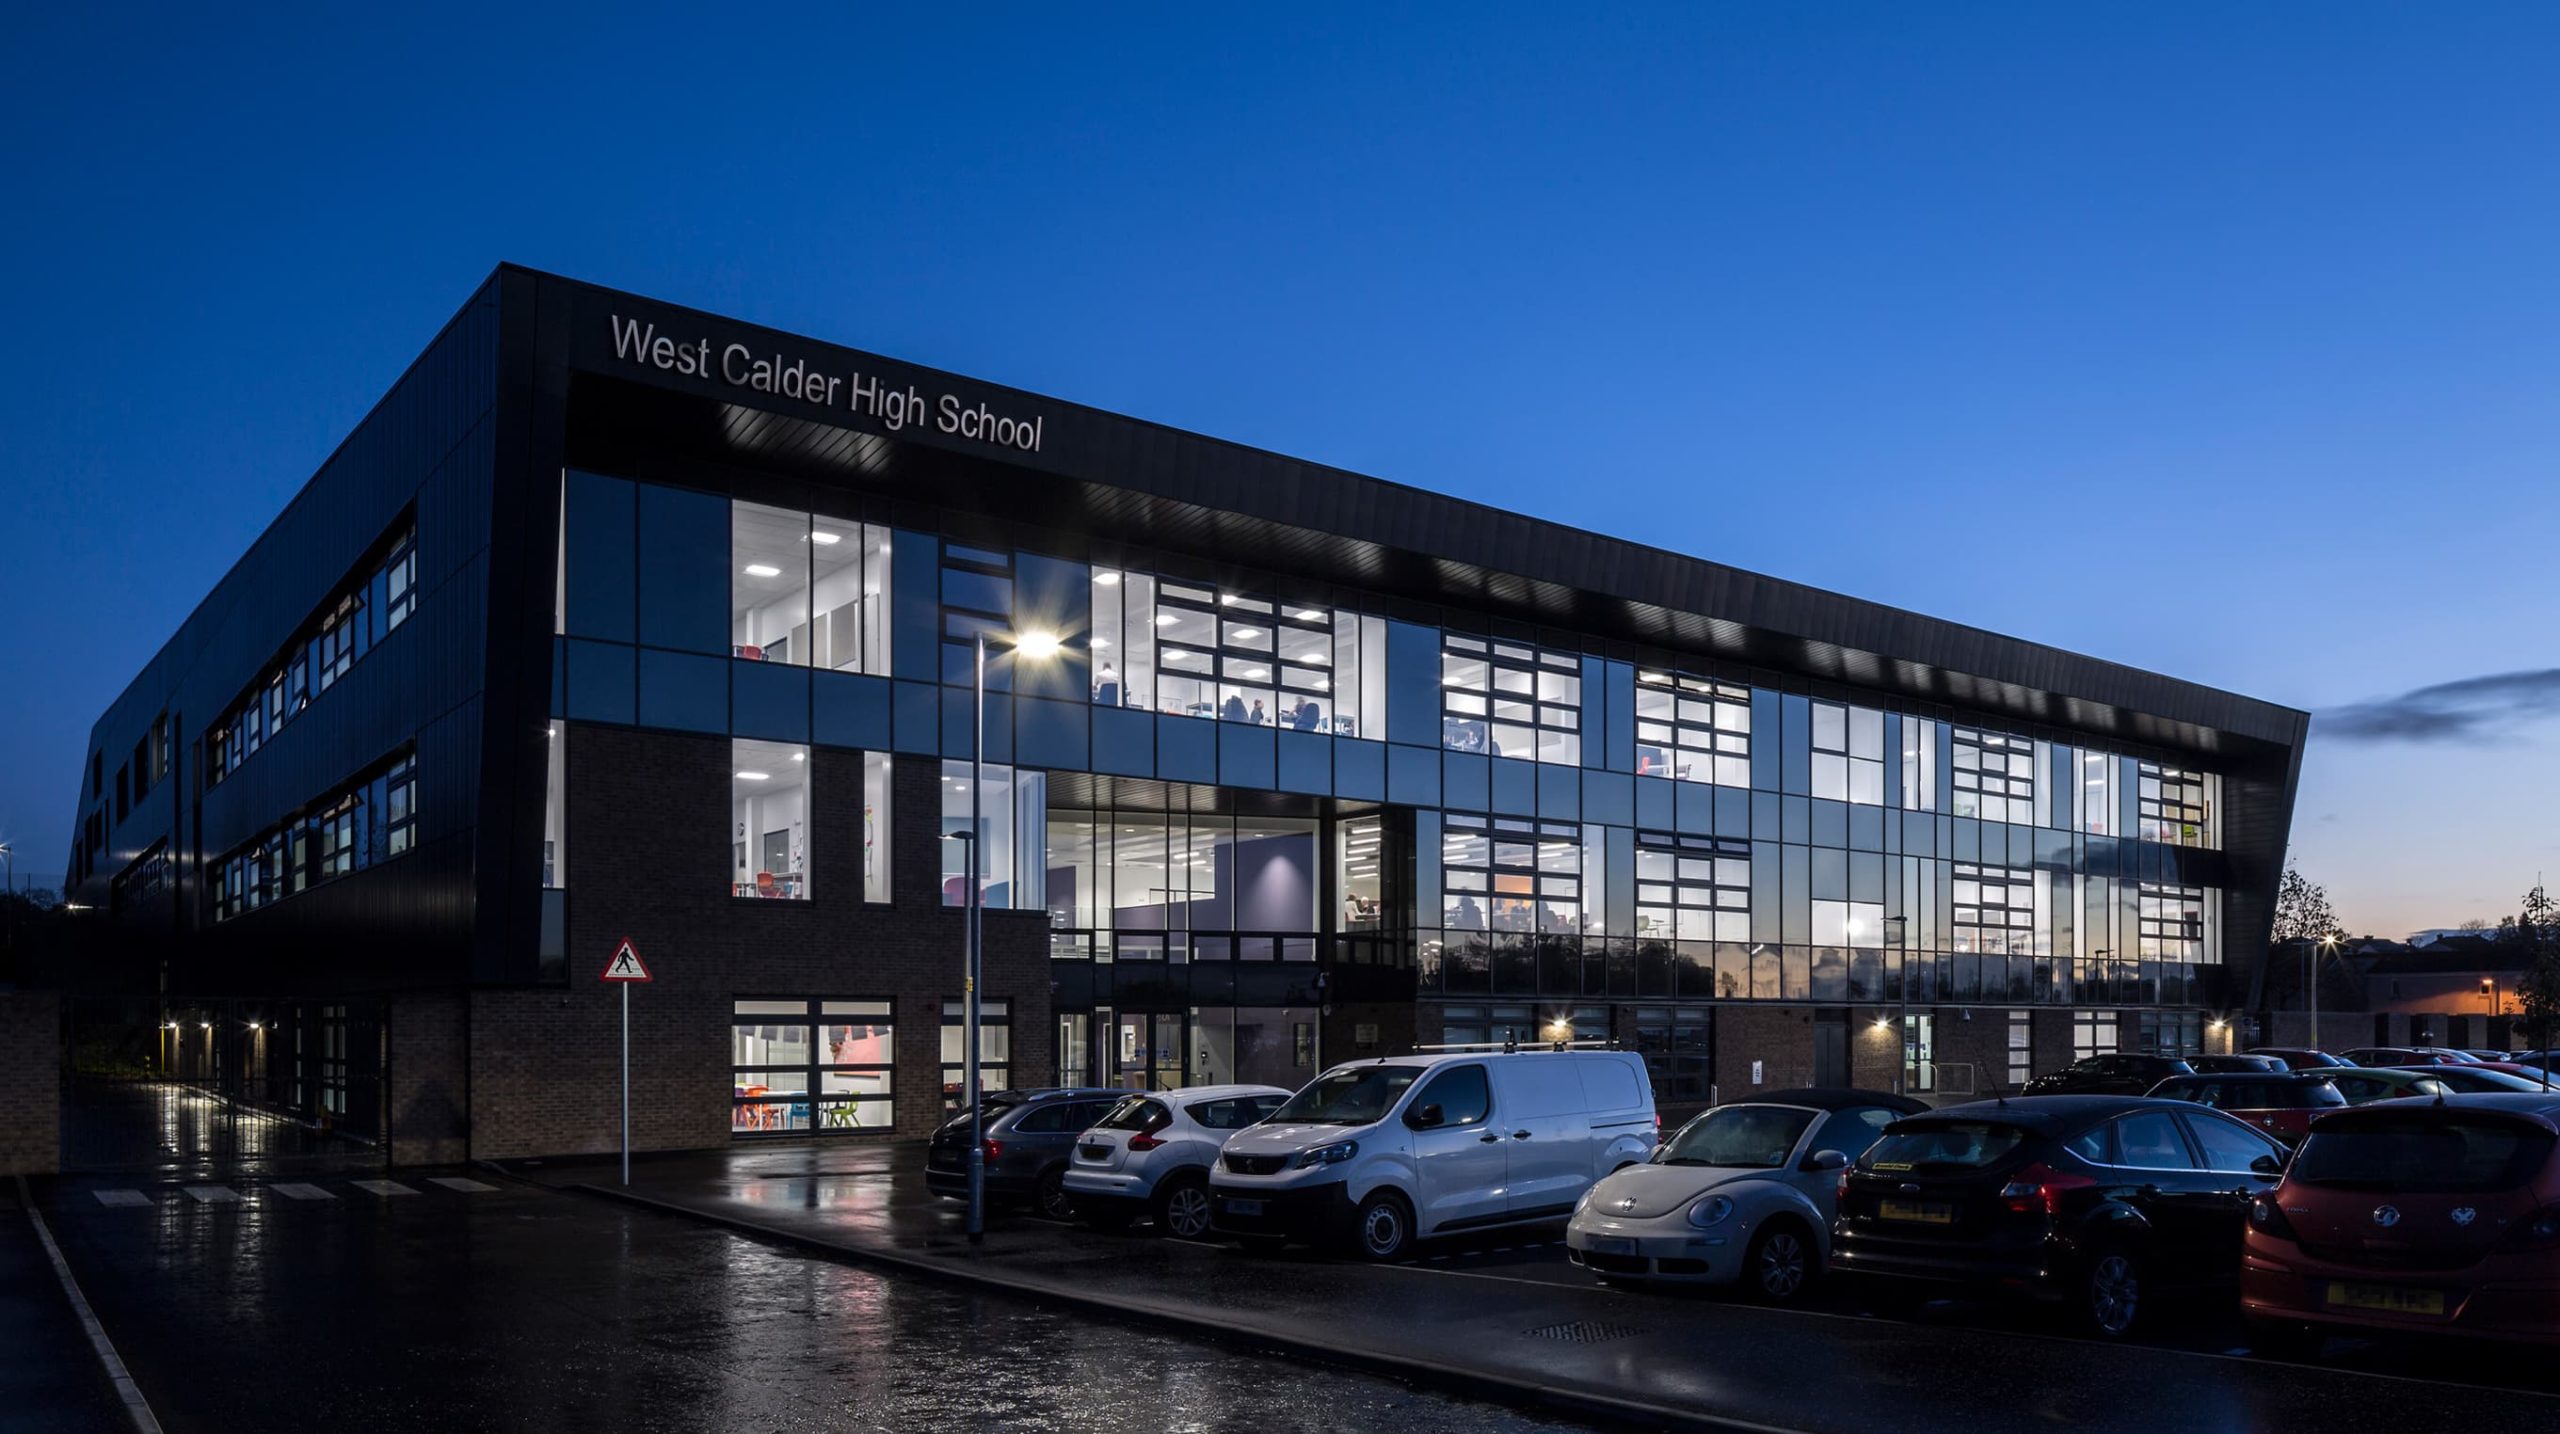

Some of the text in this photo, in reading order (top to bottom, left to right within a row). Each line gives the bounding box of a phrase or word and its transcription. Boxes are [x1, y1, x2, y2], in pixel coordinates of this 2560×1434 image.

[611, 314, 1043, 452] West Calder High School
